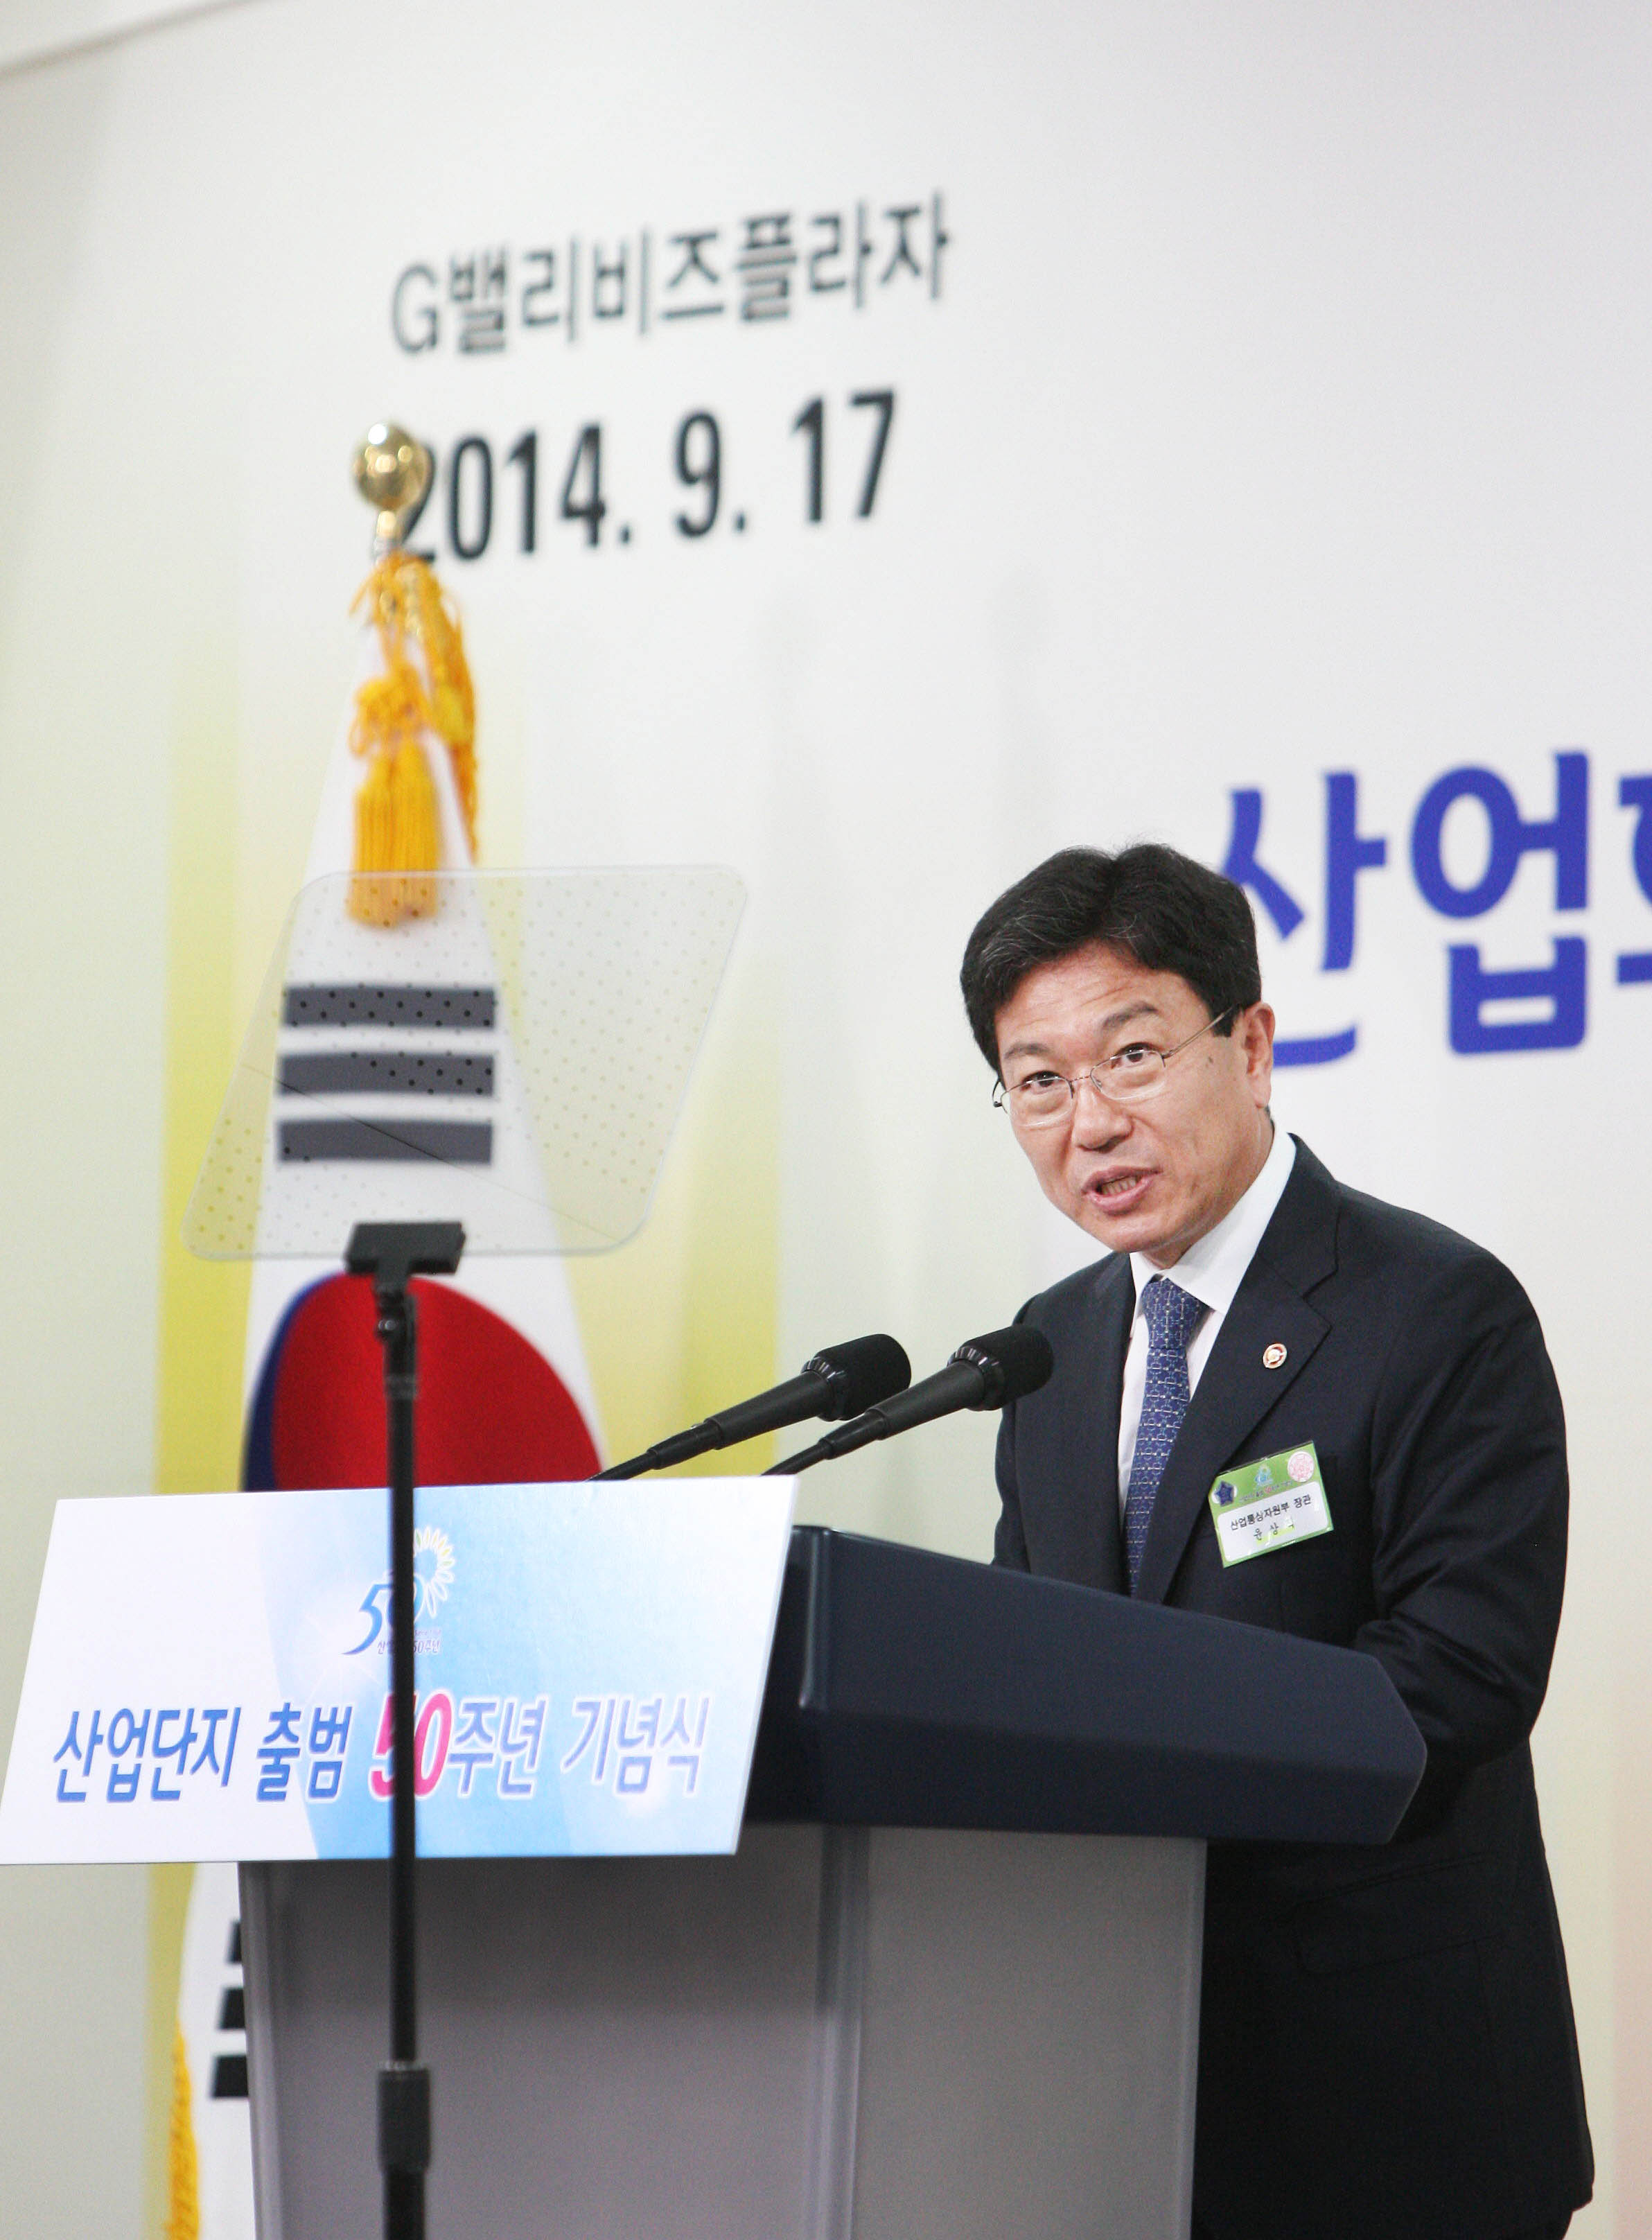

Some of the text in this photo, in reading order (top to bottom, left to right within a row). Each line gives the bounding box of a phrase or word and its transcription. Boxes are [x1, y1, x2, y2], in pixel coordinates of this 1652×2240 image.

[392, 189, 949, 355] G밸리비즈플라자
[674, 408, 748, 539] 9.
[791, 385, 897, 524] 17
[1294, 1494, 1312, 1509] 장관
[53, 1692, 711, 1802] 산업단지 출범 50주년 기념식
